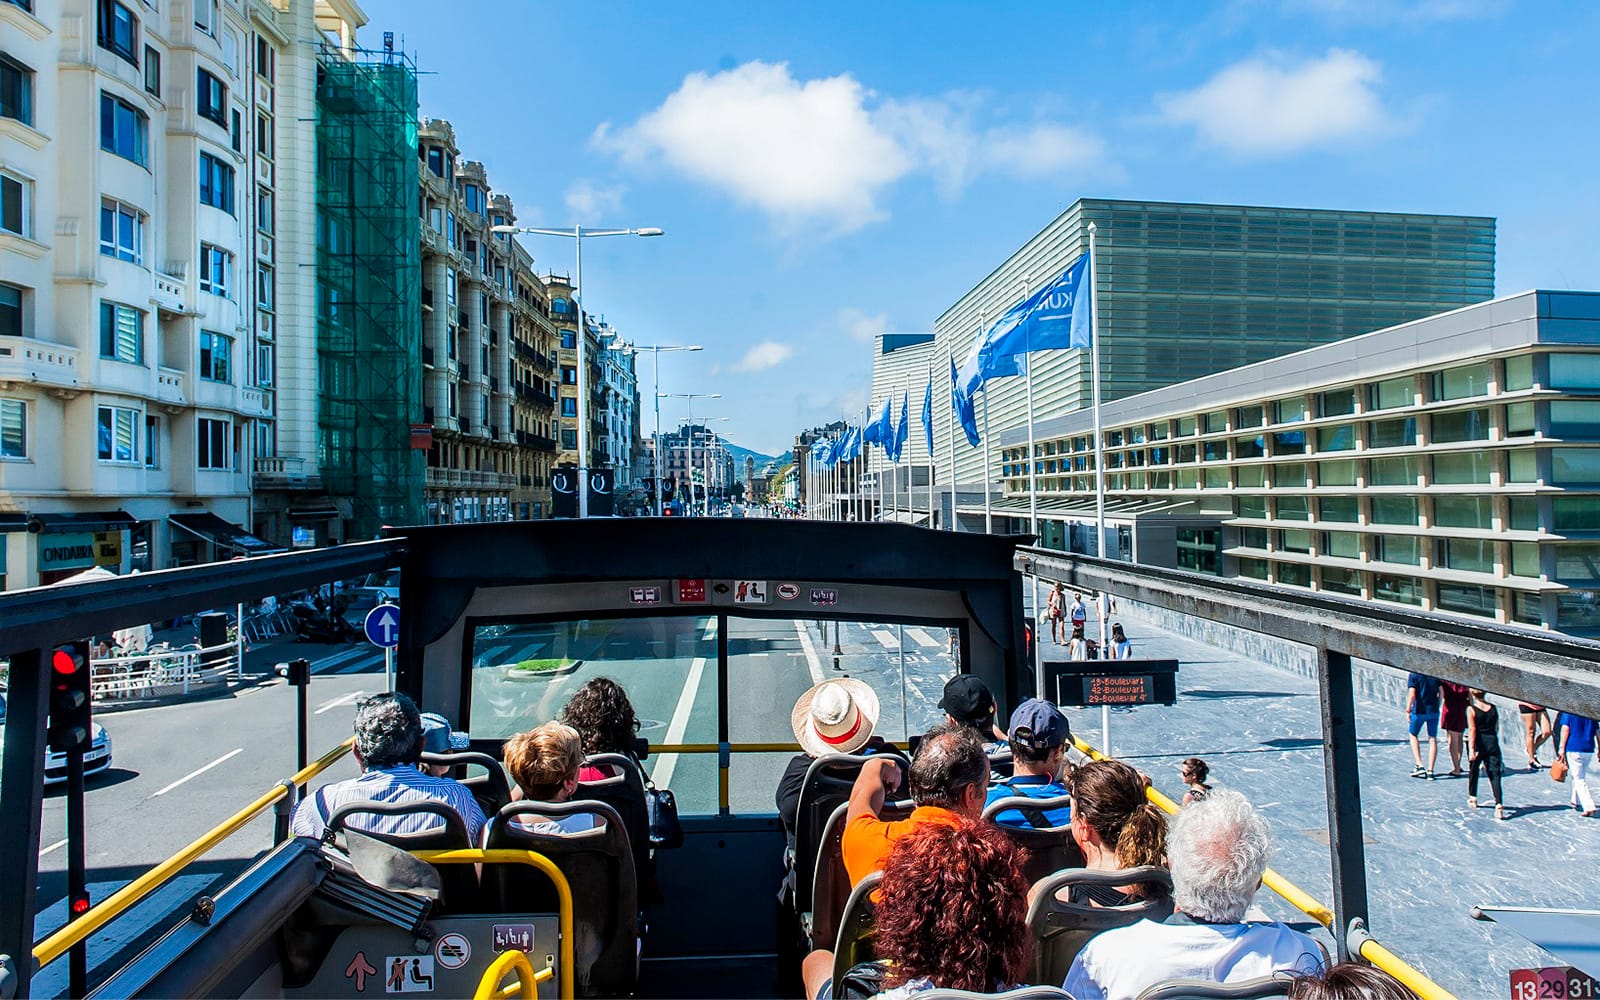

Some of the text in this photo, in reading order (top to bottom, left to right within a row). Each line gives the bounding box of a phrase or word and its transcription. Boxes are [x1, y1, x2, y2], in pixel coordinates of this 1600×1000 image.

[1515, 981, 1537, 1000] 13
[1541, 980, 1565, 999] 29
[1569, 978, 1592, 998] 31
